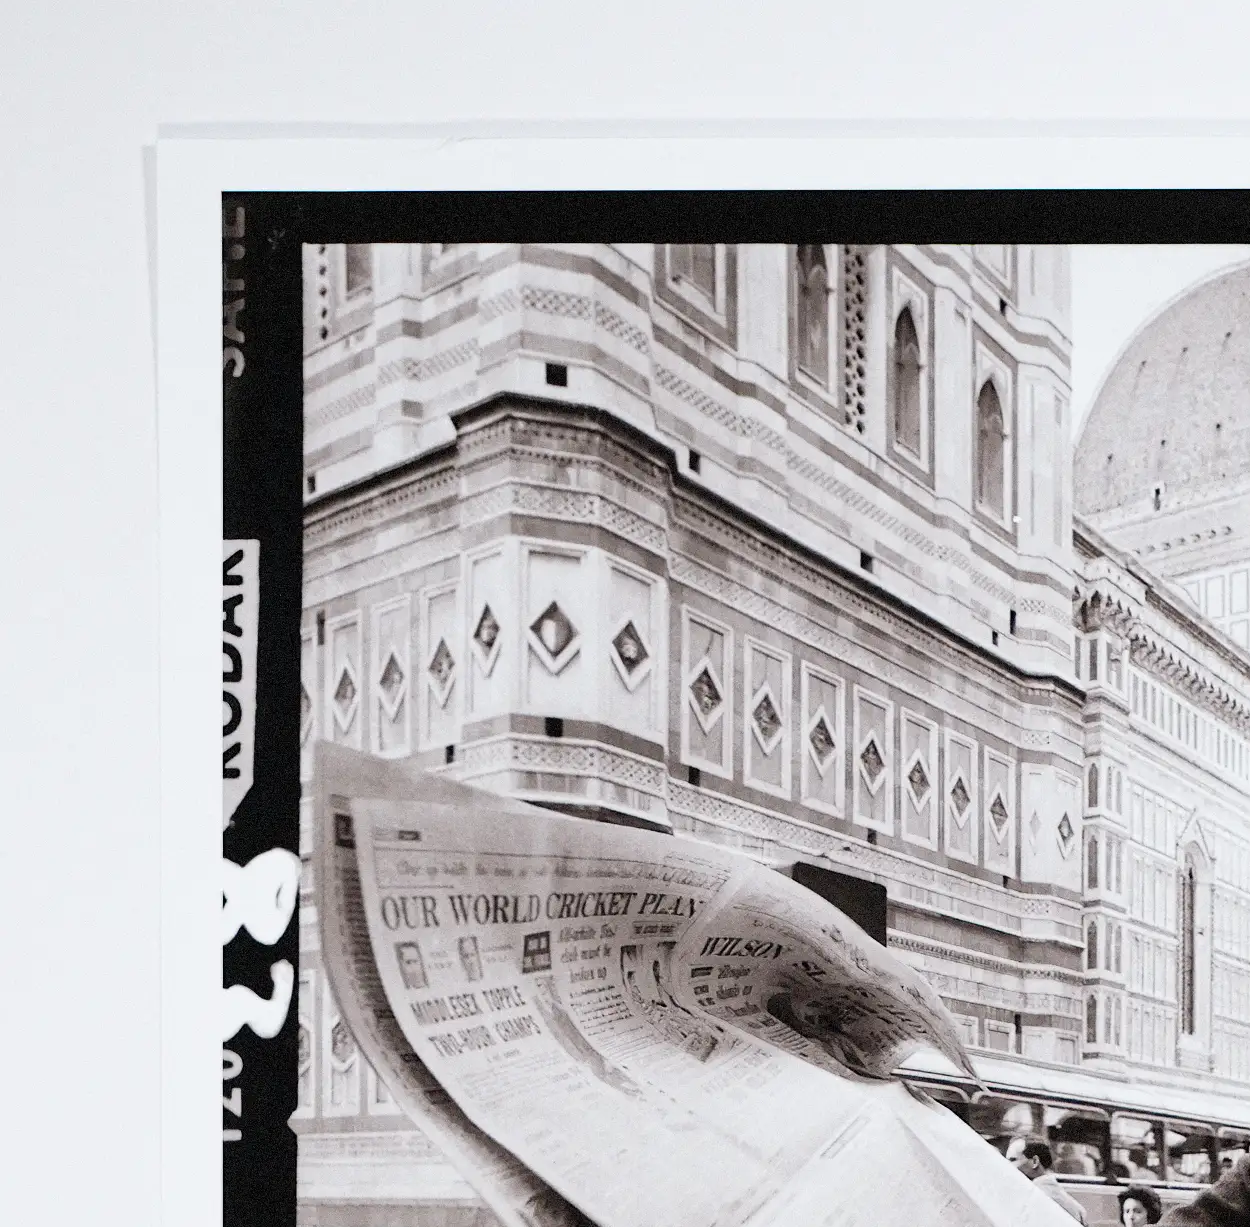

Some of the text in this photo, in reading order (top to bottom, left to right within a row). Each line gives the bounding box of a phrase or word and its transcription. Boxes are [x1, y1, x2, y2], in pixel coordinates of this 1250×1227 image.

[381, 895, 440, 930] OUR
[449, 893, 541, 926] WORLD
[545, 889, 638, 921] CRICKET
[410, 985, 527, 1026] MIDDLESEX TOPPLE
[495, 1015, 541, 1043] CHAMPS
